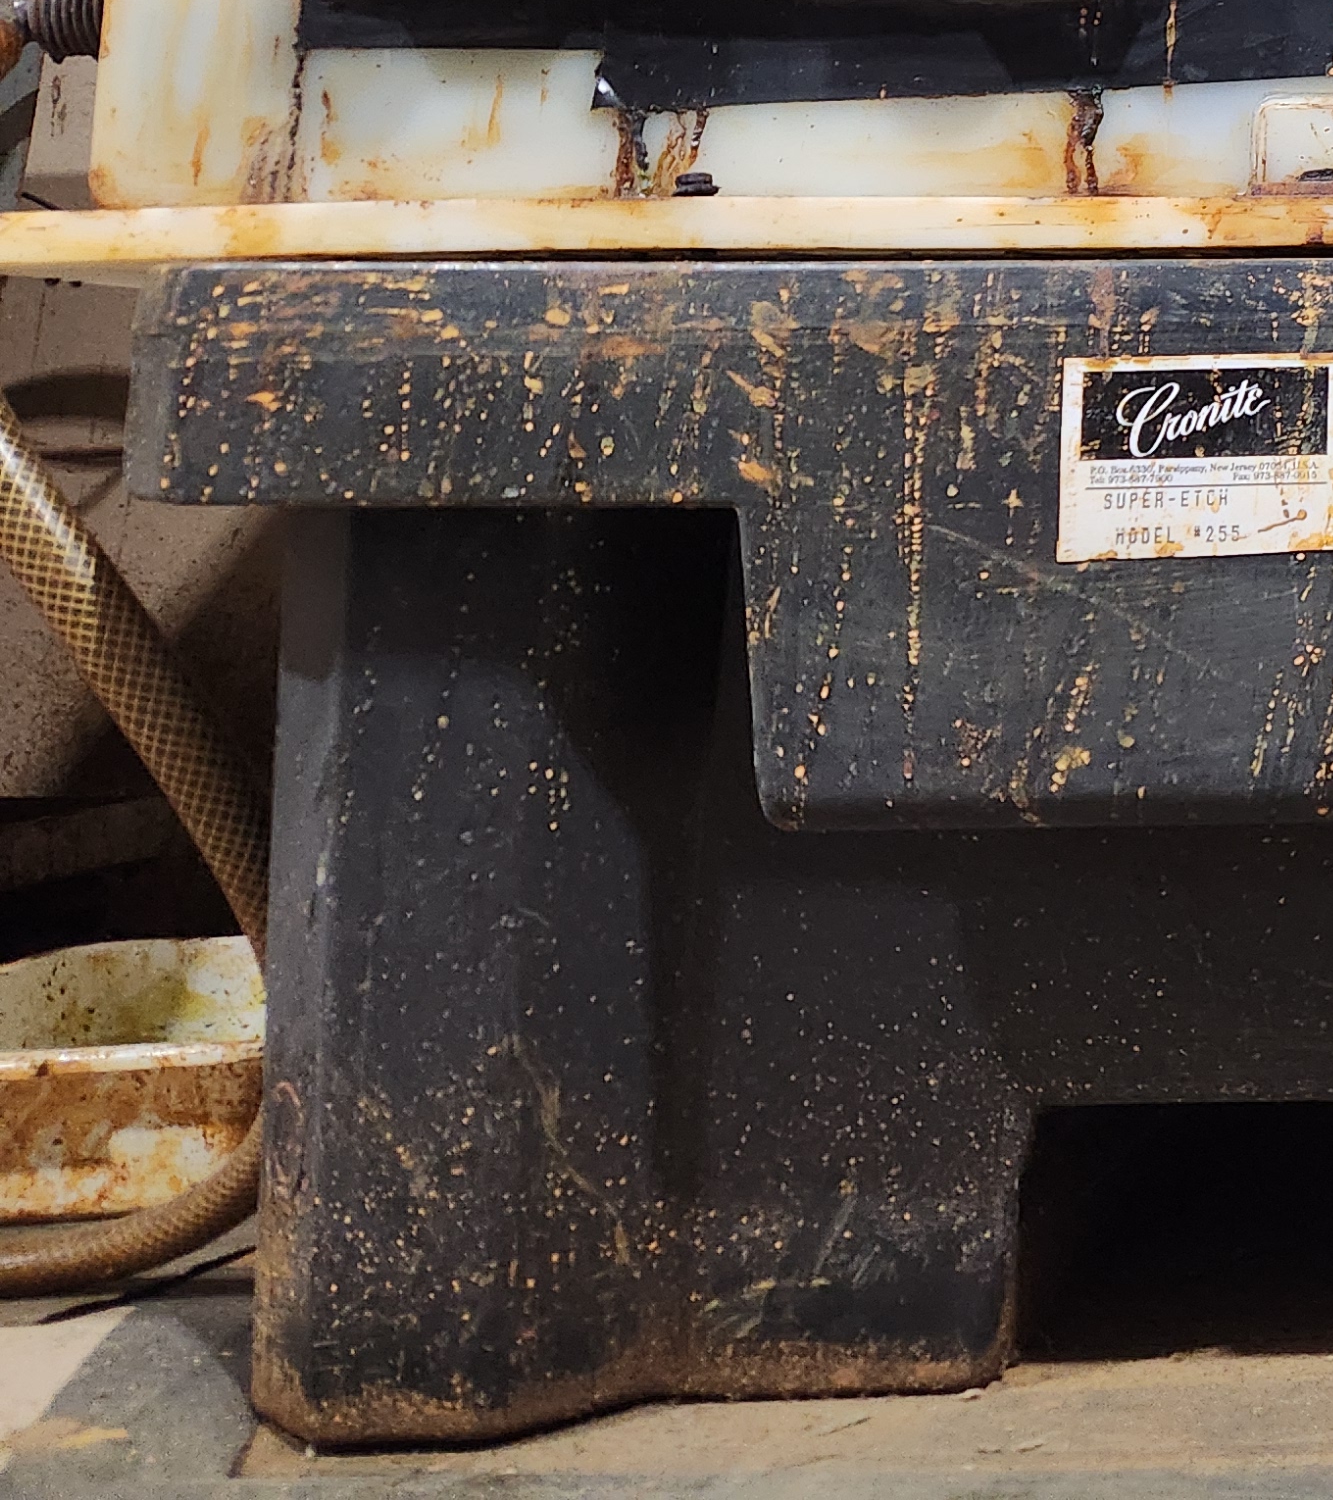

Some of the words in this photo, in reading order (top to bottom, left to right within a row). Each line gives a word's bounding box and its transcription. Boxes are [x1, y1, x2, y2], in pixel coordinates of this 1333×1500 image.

[1116, 379, 1271, 458] Cronite
[1210, 462, 1229, 472] New
[1230, 462, 1257, 472] Jersey
[1103, 490, 1229, 510] SUPER-ETCH
[1115, 525, 1177, 546] MODEL
